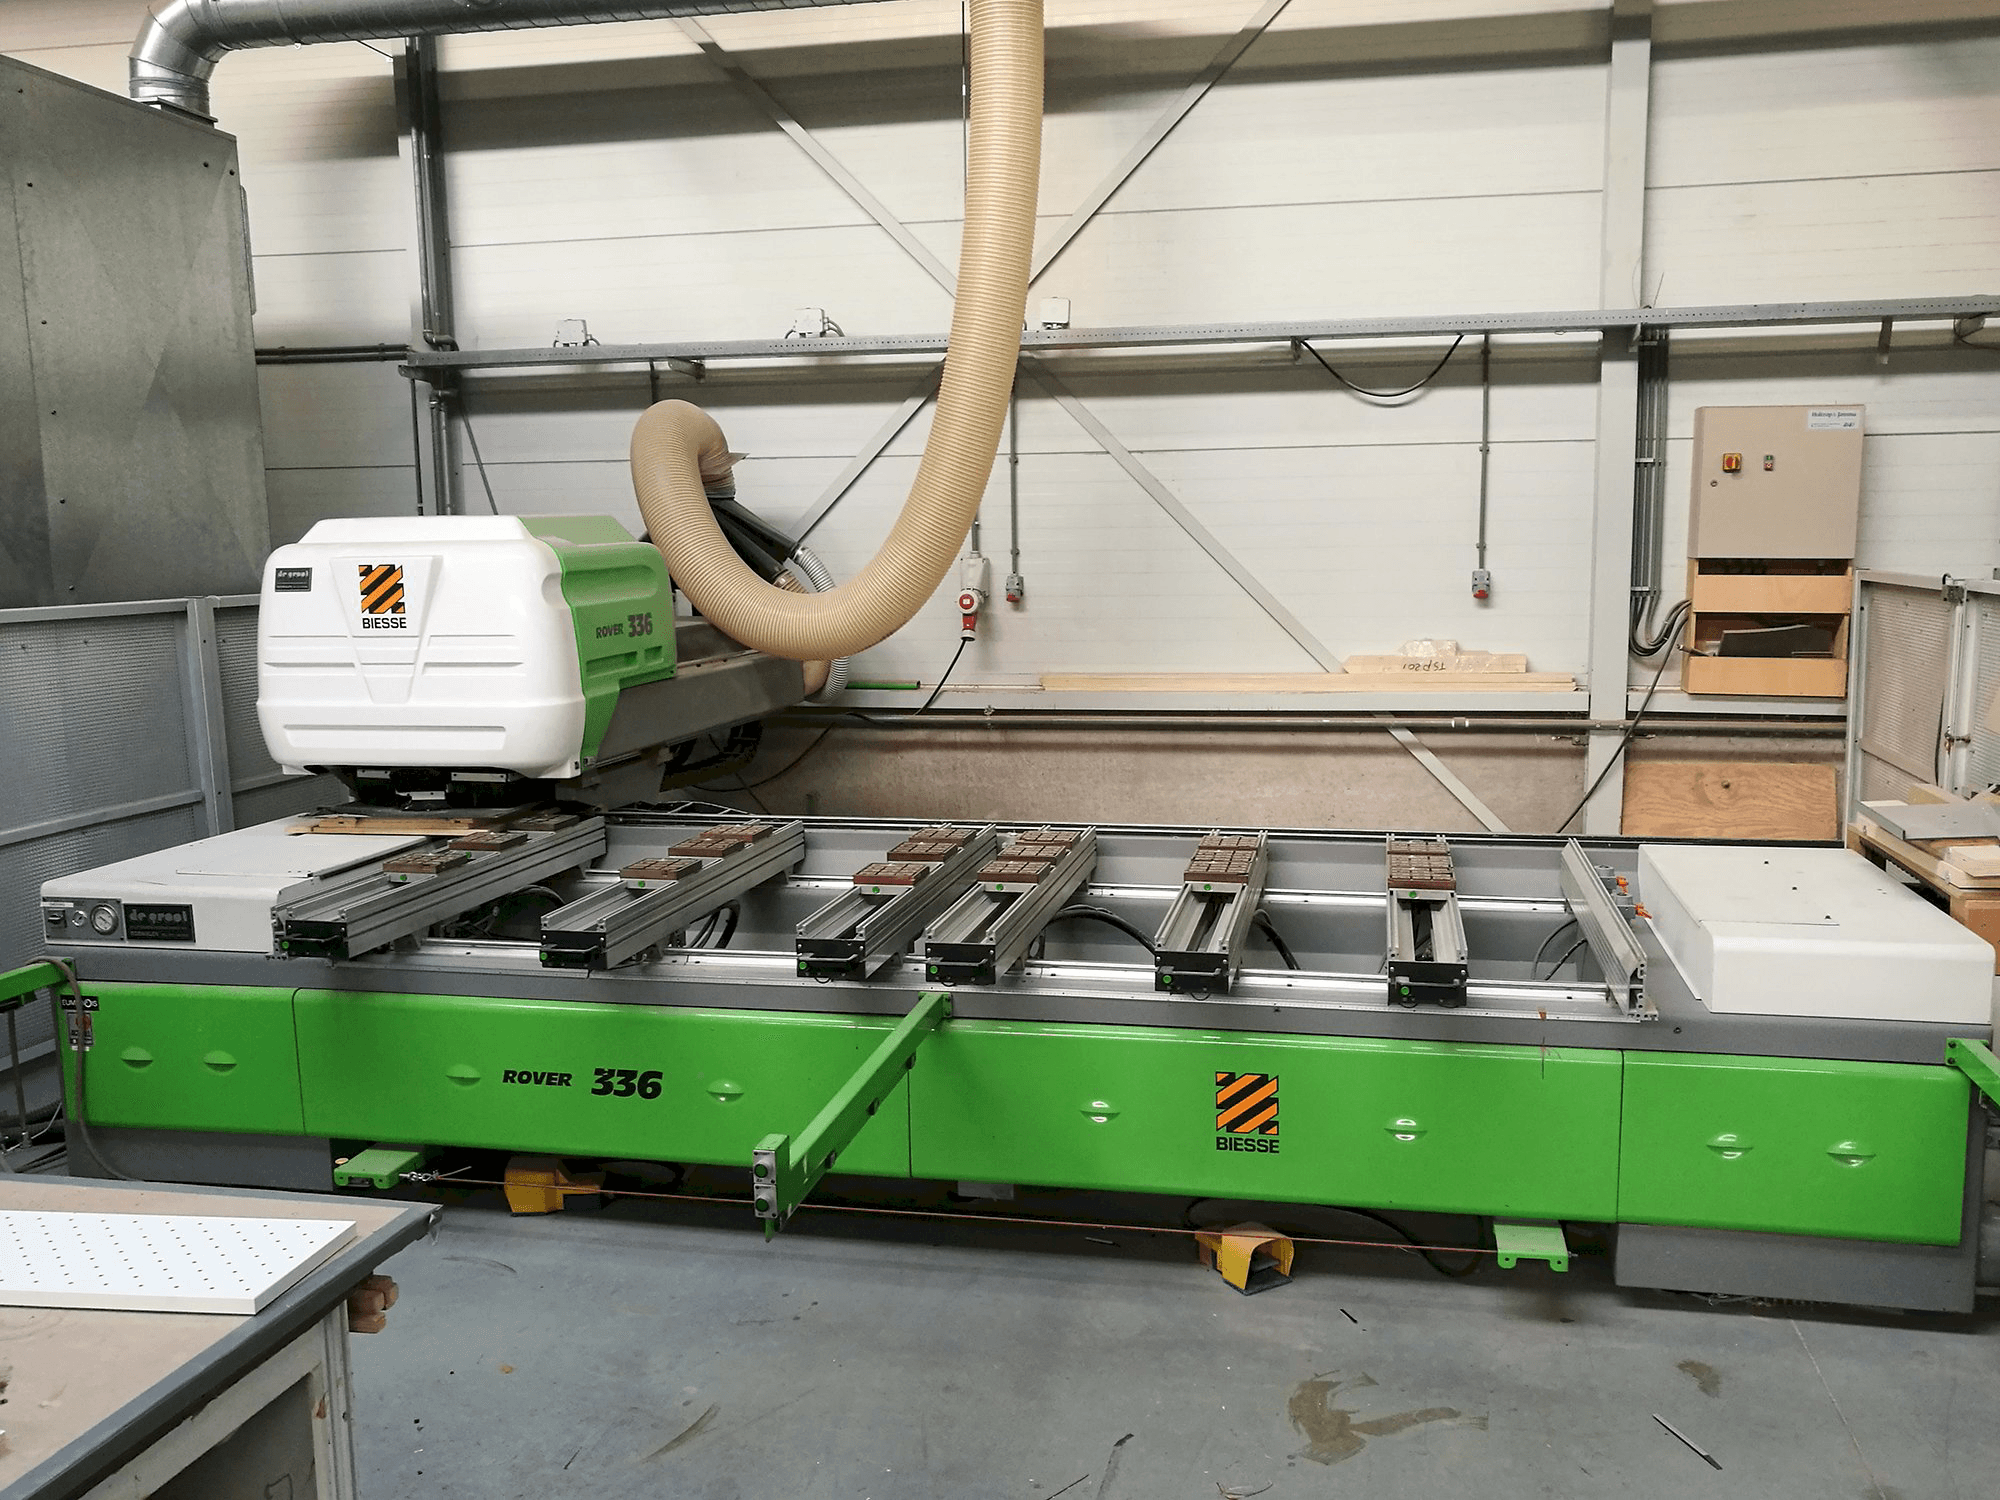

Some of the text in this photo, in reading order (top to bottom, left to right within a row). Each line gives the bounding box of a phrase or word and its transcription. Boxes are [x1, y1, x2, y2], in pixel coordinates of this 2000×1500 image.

[362, 617, 407, 629] BIESSE
[596, 611, 653, 639] ROVER 336
[502, 1067, 664, 1100] ROVER 336
[1216, 1136, 1280, 1154] BIESSE
